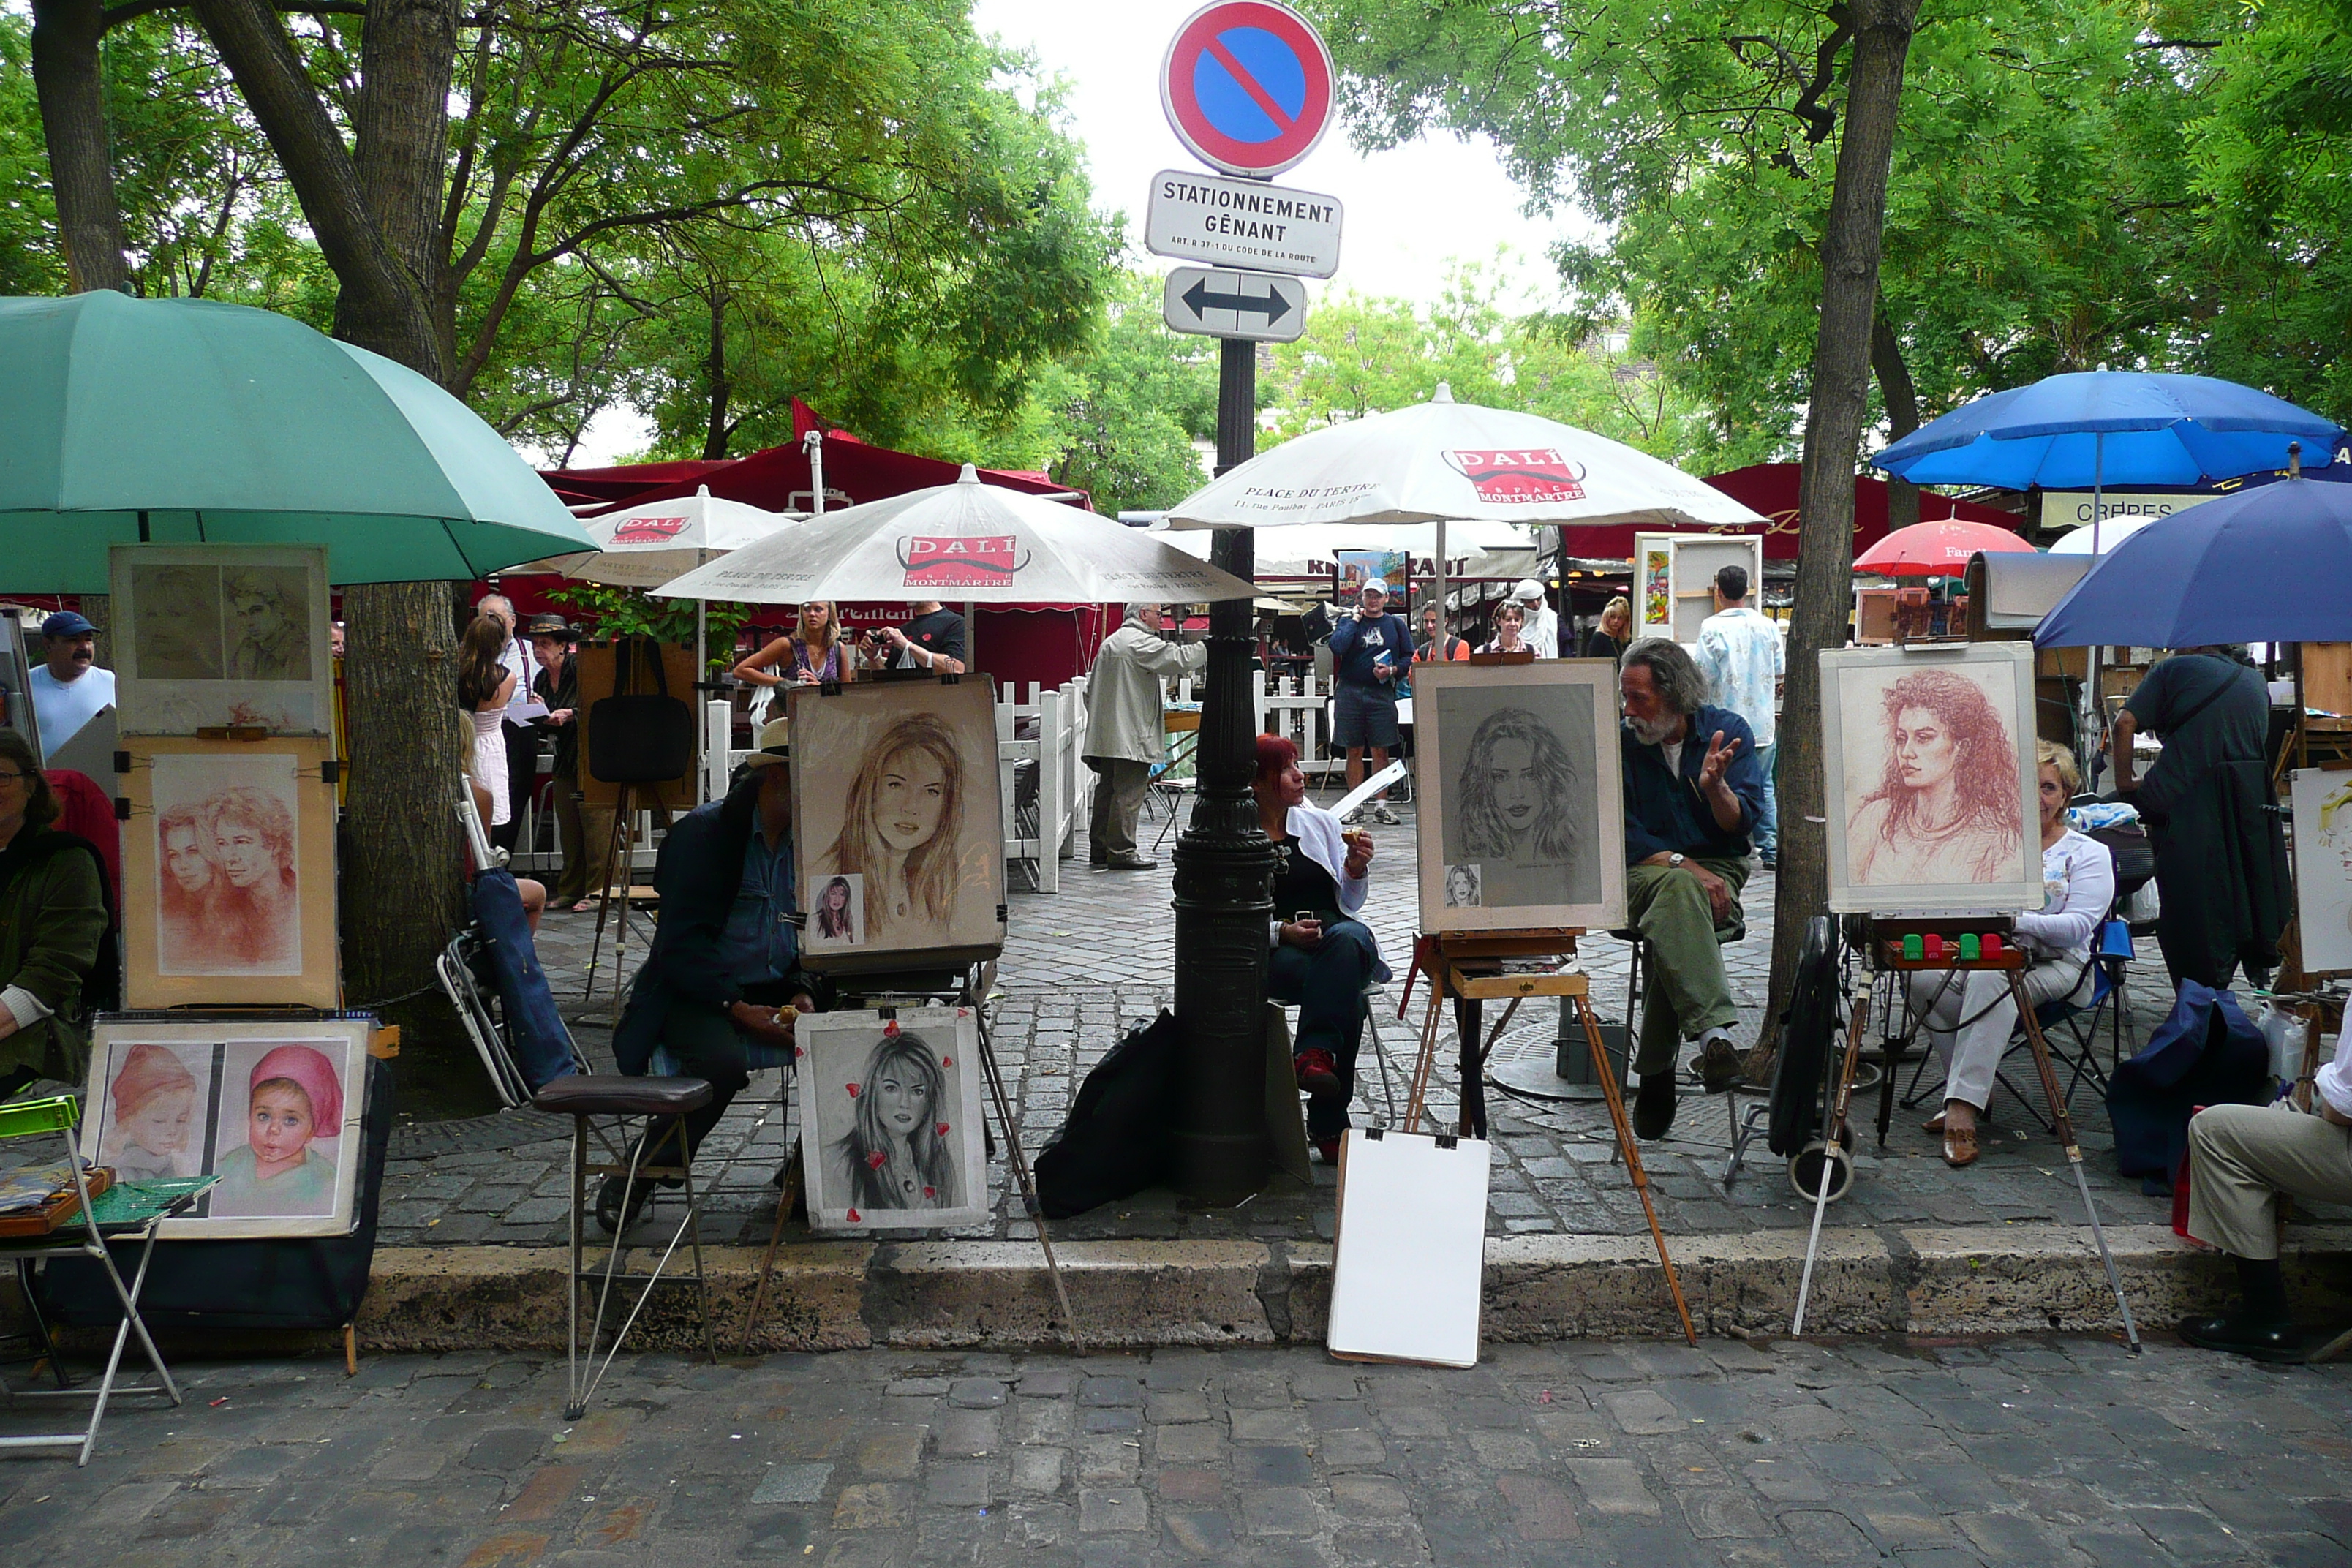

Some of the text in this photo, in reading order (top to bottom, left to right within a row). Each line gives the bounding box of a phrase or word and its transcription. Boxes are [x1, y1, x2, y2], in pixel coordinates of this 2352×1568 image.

[1163, 181, 1333, 223] STATIONNEMENT
[1205, 214, 1286, 242] GÊNANT
[1171, 235, 1190, 246] ART.
[1222, 244, 1234, 252] DU
[1237, 245, 1258, 255] CODE
[1262, 249, 1273, 257] DE
[1289, 253, 1316, 263] ROUTE
[1245, 483, 1381, 499] PLACE DU TERTRE
[1477, 483, 1580, 494] ESPACE
[1479, 490, 1585, 503] MONTMARTRE
[1251, 502, 1269, 510] rue
[1316, 498, 1346, 509] PARIS
[911, 537, 1014, 554] DALÍ
